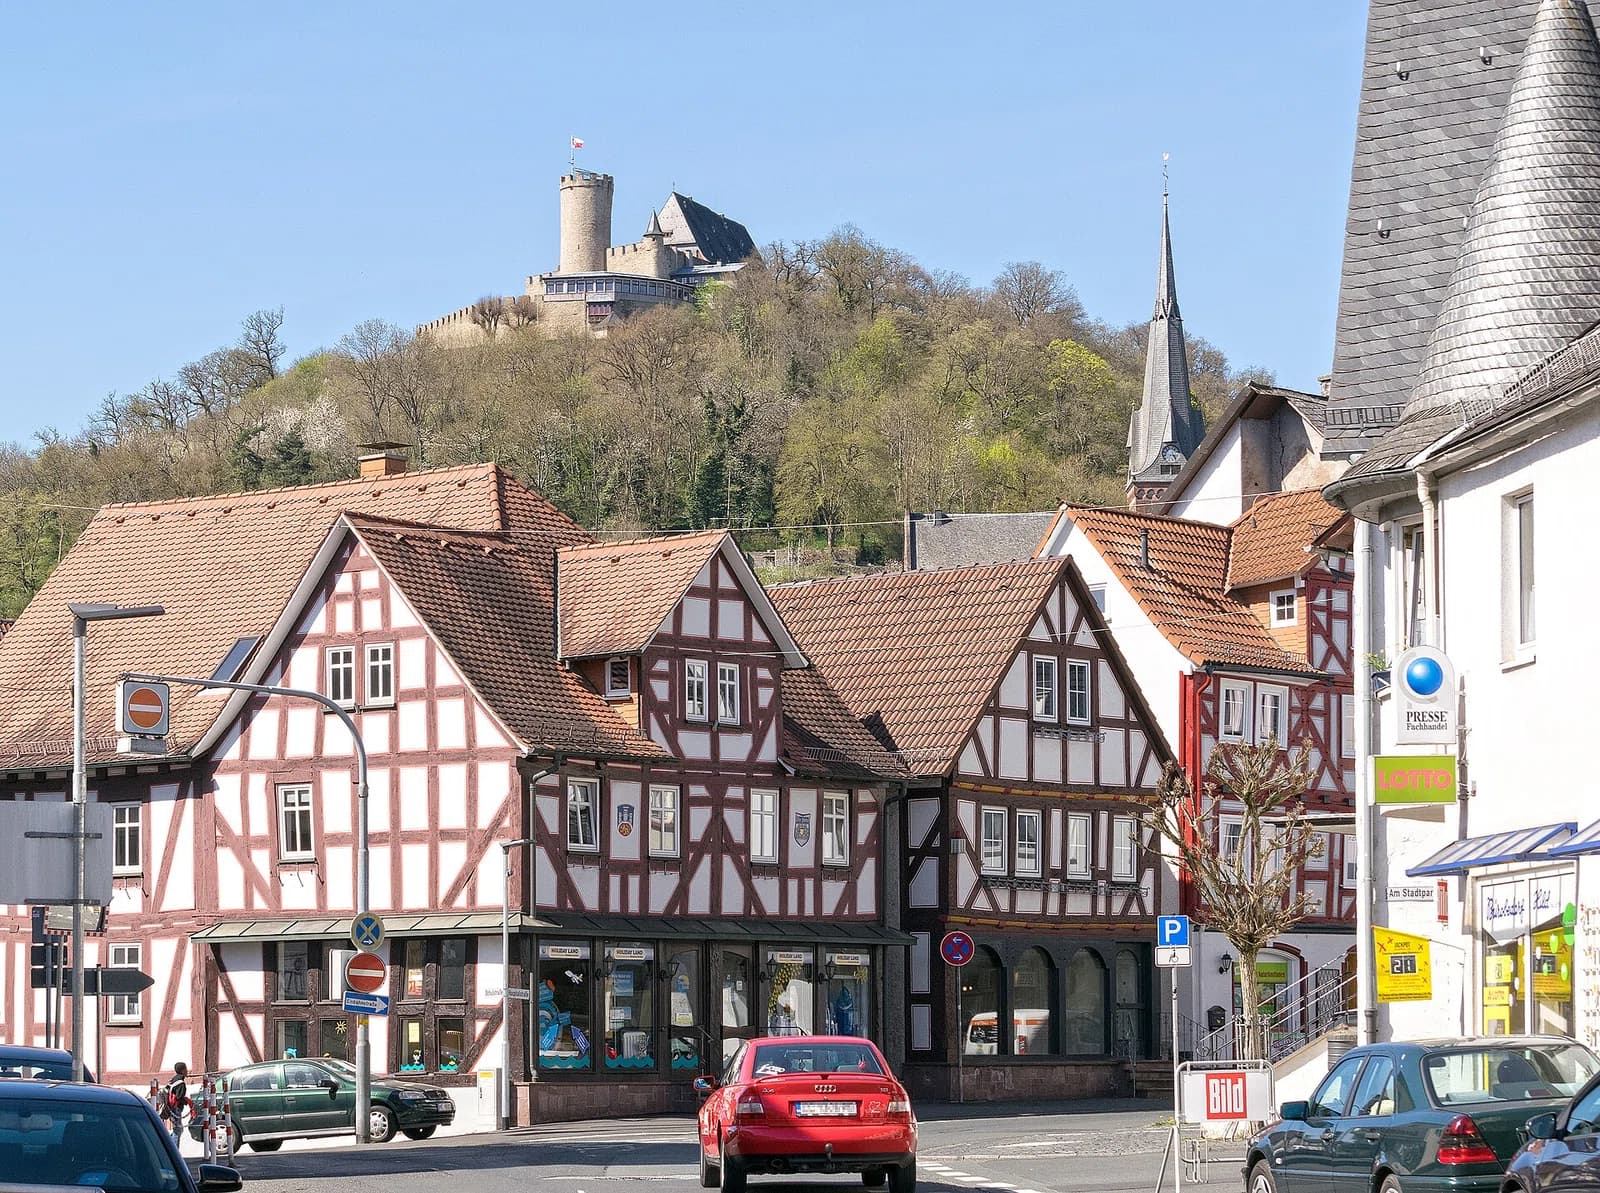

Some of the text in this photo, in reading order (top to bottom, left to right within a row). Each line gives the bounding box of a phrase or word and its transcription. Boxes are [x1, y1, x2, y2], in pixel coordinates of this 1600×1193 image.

[1406, 711, 1448, 722] PRESSE
[1406, 723, 1448, 731] Fachhandel
[1378, 769, 1452, 790] LOTTO
[1389, 888, 1433, 899] Am Stadtpar
[1165, 919, 1182, 943] P
[1393, 959, 1412, 973] 21
[1208, 1077, 1244, 1113] Bild
